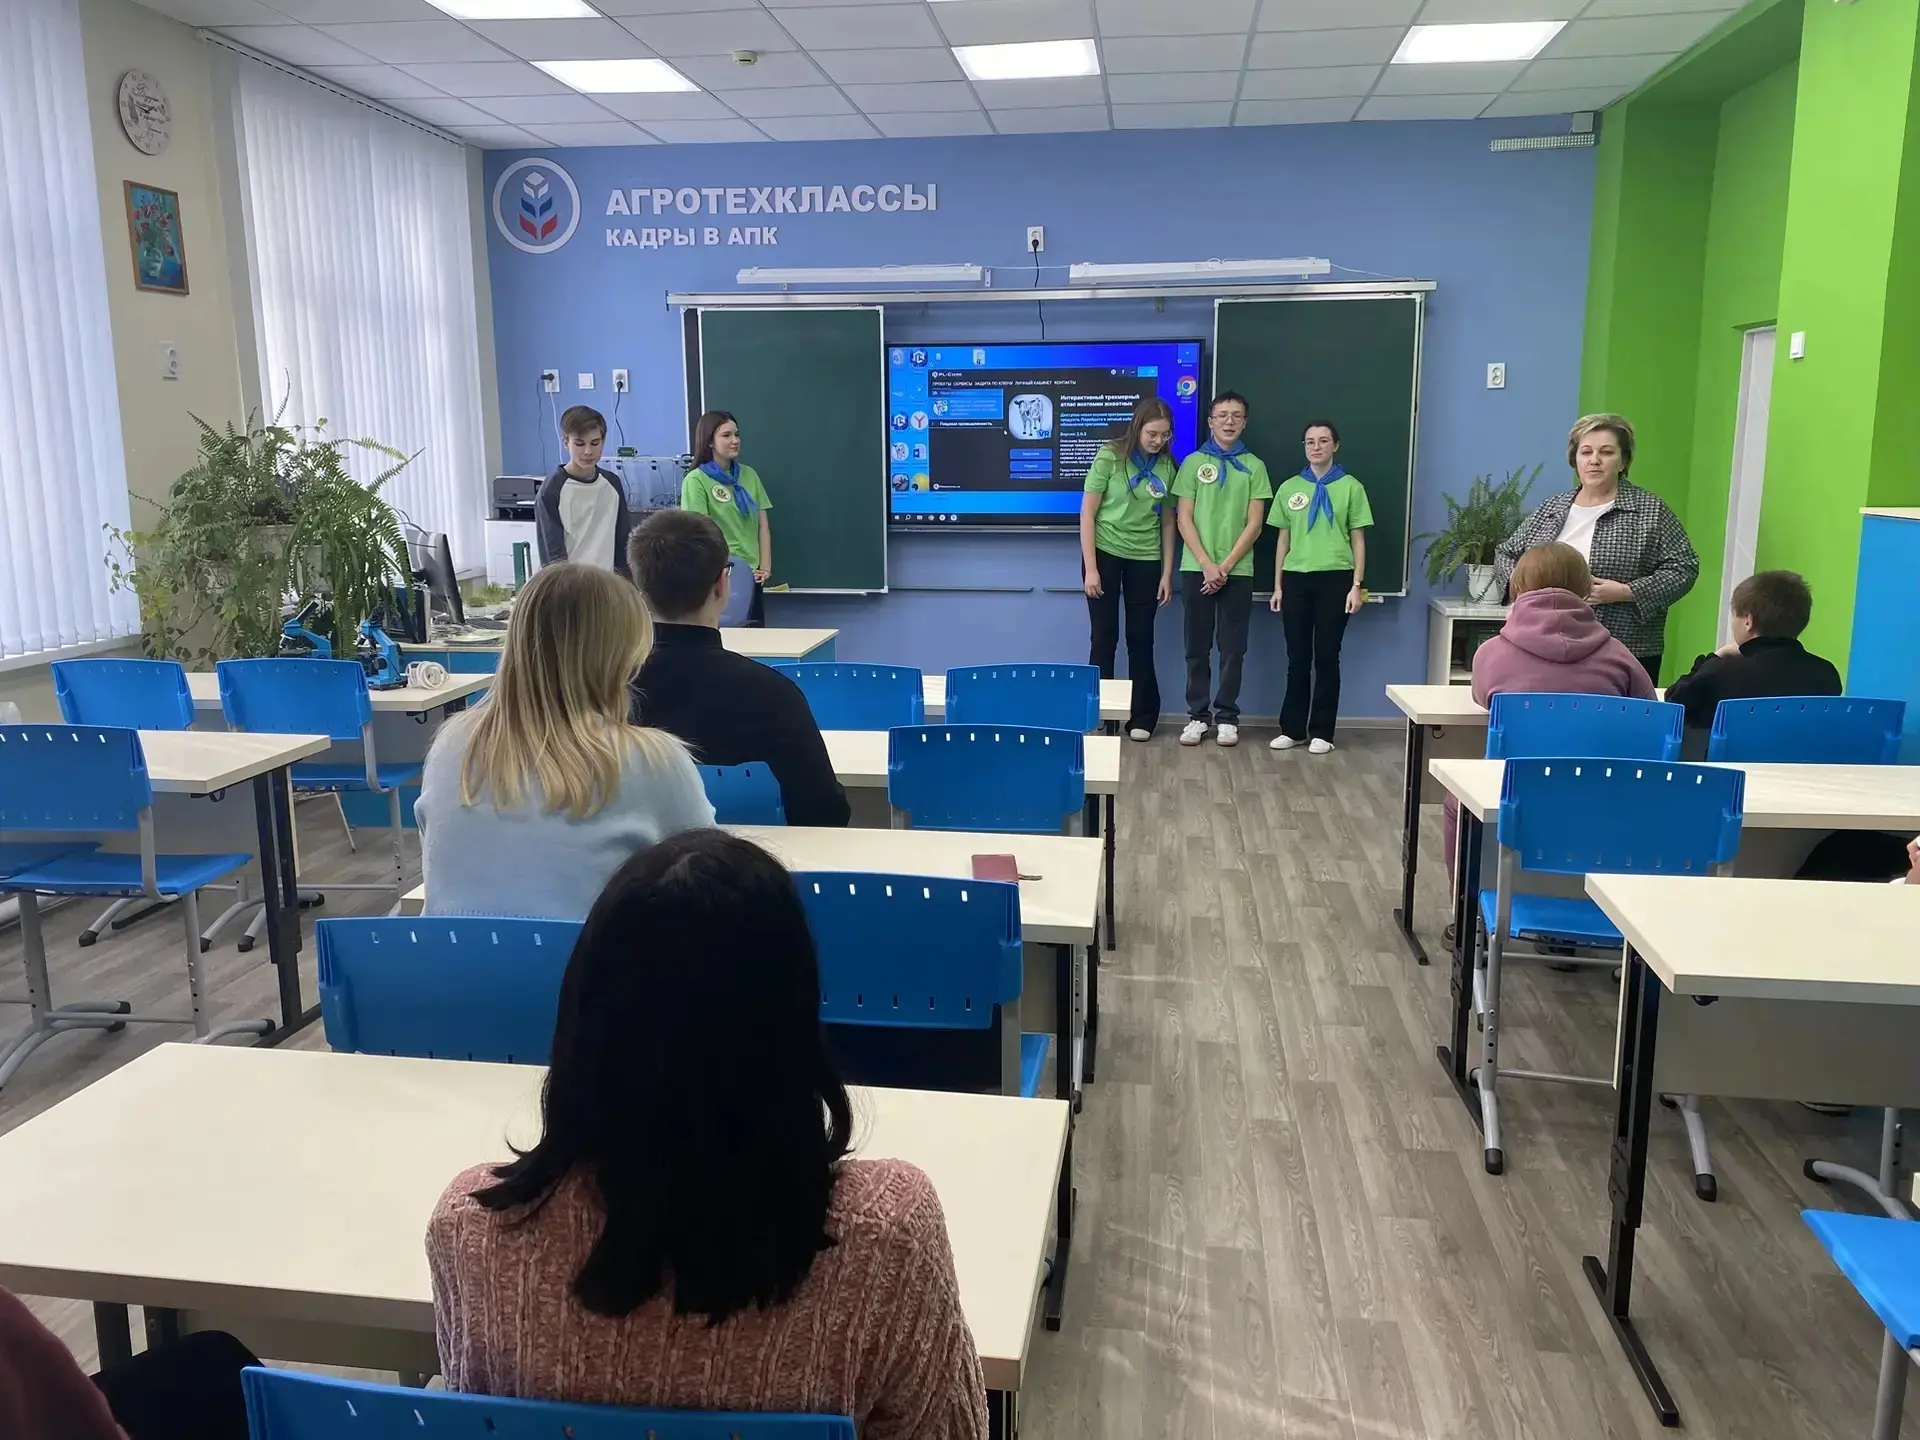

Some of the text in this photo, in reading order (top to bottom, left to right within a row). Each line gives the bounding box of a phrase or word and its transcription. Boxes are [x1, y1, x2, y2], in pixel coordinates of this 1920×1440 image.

[605, 183, 938, 216] АГРОТЕХКЛАССЫ
[605, 227, 779, 250] КАДРЫ В АПК
